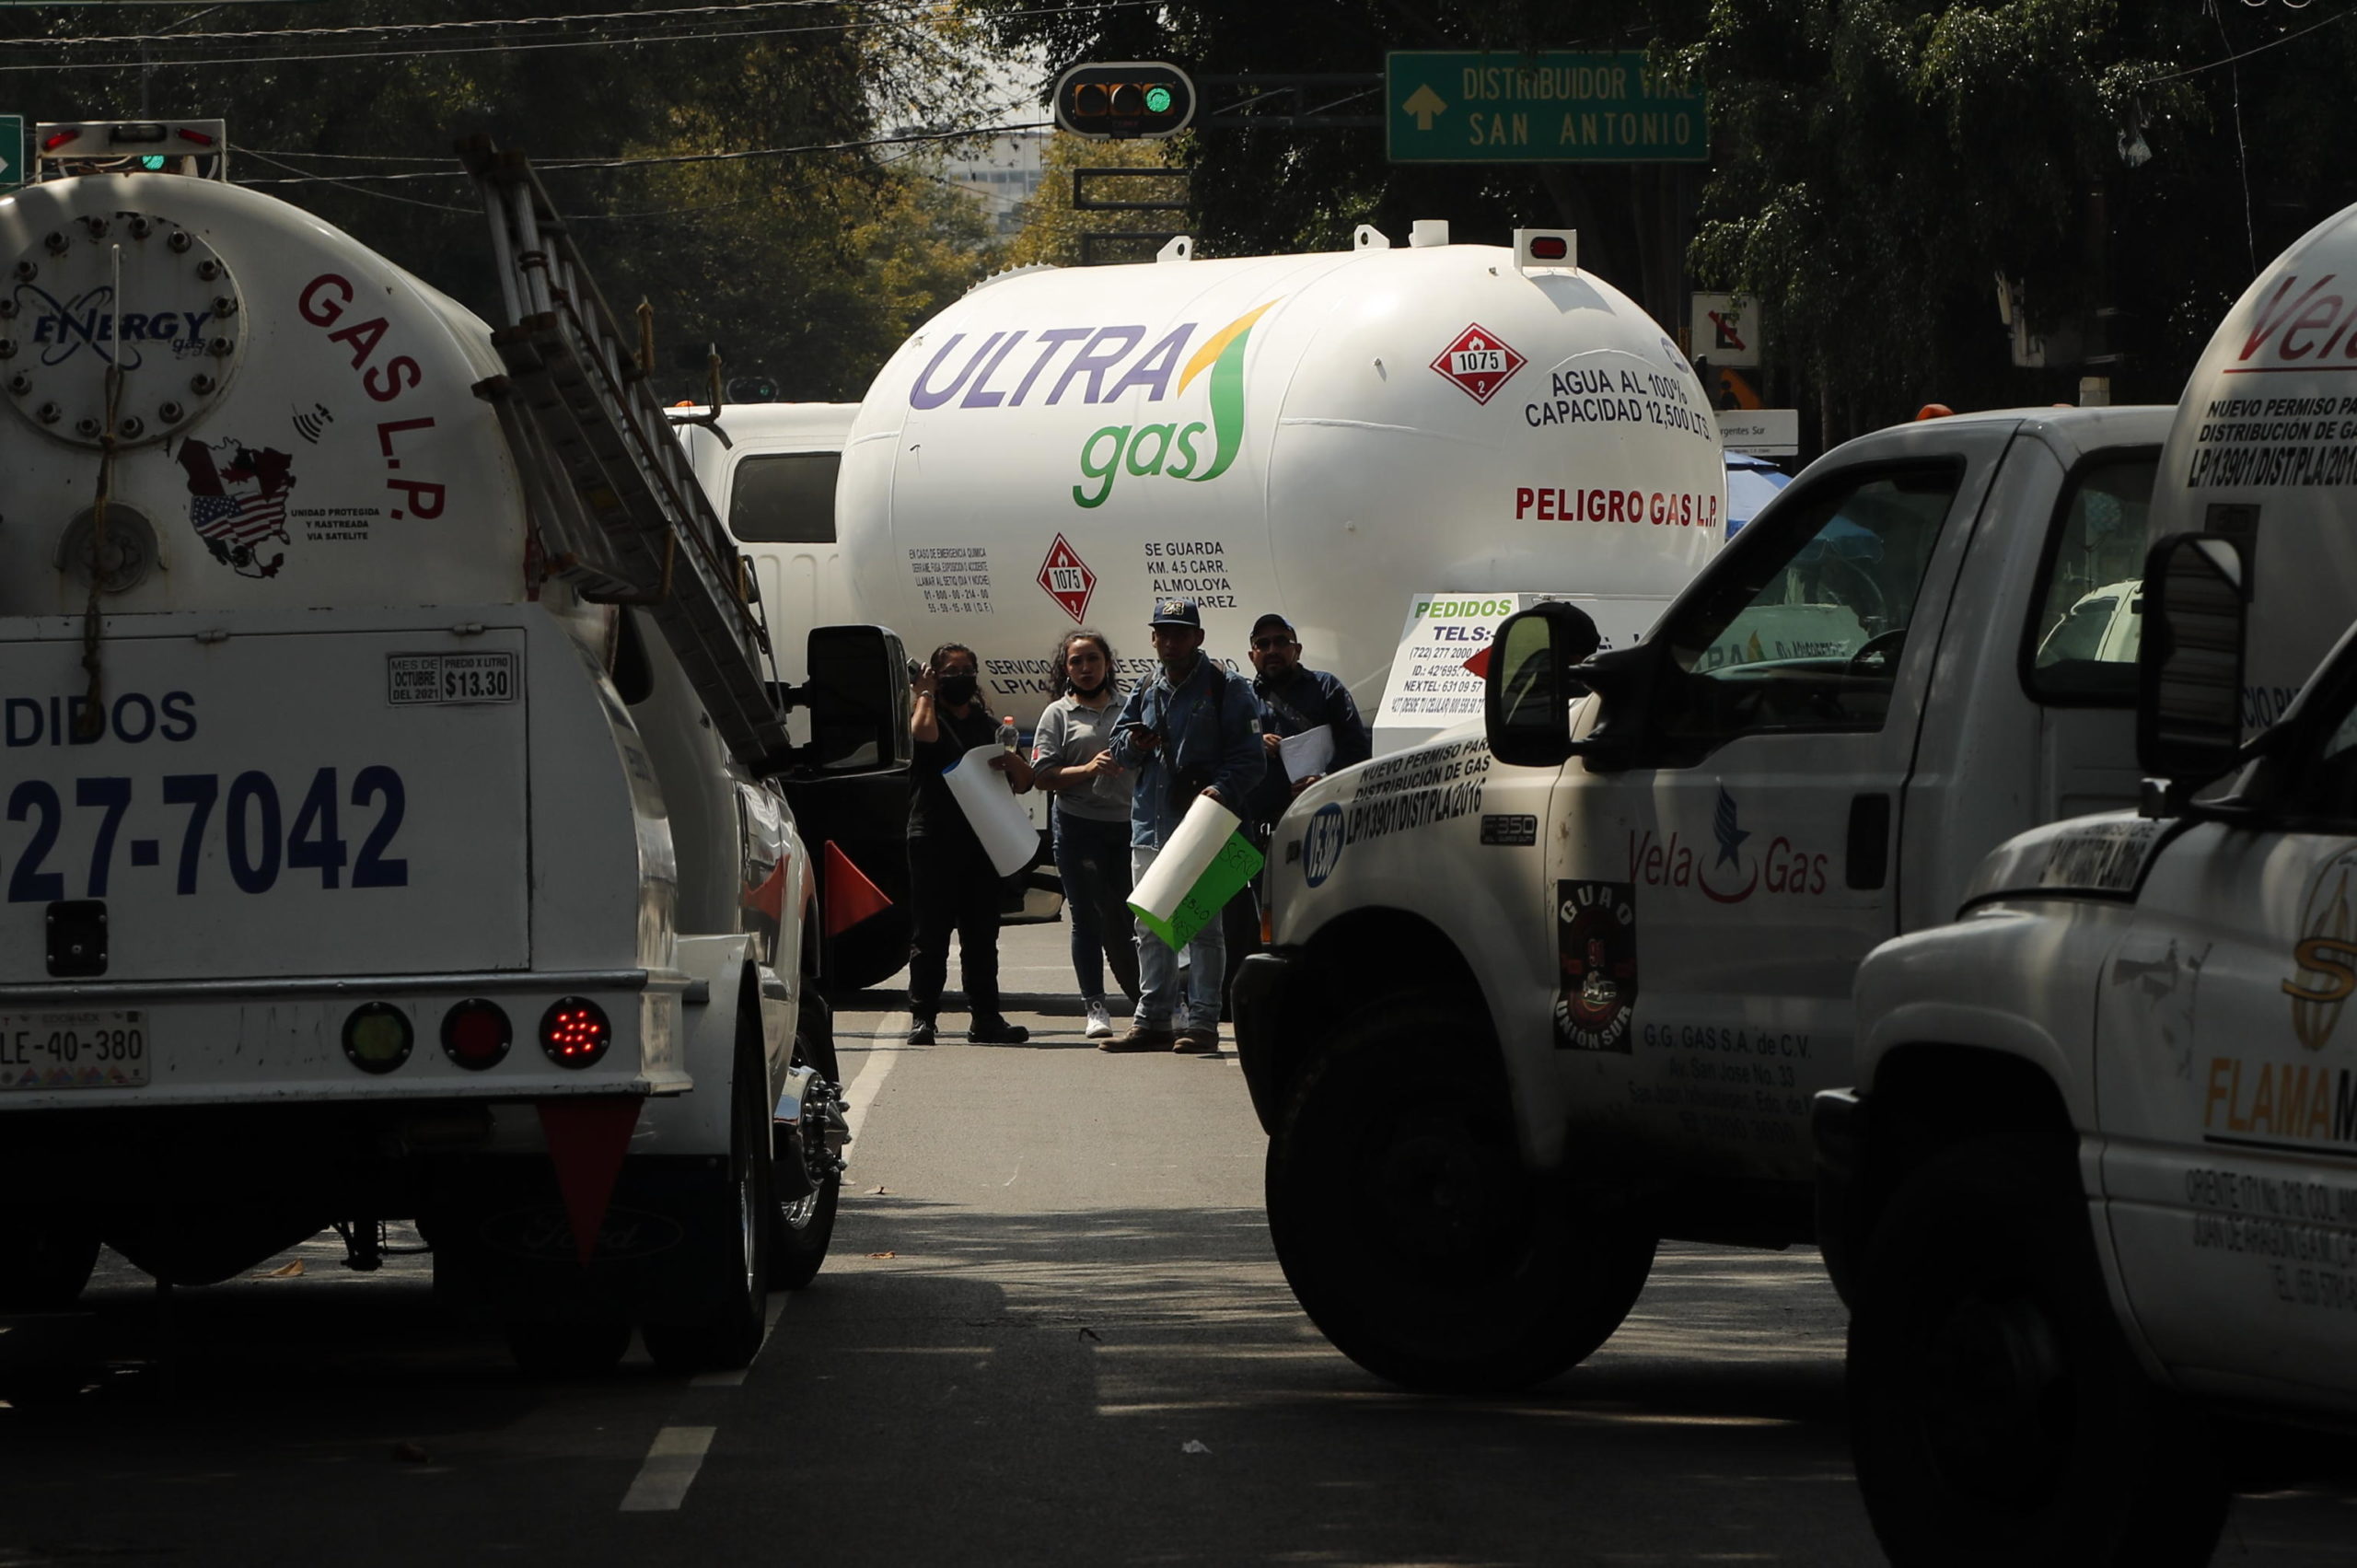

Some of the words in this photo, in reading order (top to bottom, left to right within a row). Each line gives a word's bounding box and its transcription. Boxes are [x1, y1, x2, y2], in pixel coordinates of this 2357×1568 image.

[1463, 66, 1626, 100] DISTRIBUIDOR
[1469, 111, 1528, 146] SAN
[1560, 110, 1691, 146] ANTONIO
[33, 308, 213, 344] ENERGY
[2238, 274, 2357, 361] Vel
[298, 273, 422, 402] GAS
[910, 323, 1199, 410] ULTRA
[1458, 351, 1500, 372] 1075
[1478, 380, 1486, 395] 2
[1552, 369, 1615, 397] AGUA
[1620, 370, 1647, 394] AL
[1648, 373, 1688, 405] 100%
[2208, 400, 2262, 418] NUEVO
[2263, 397, 2338, 417] PERMISO
[1525, 399, 1642, 427] CAPACIDAD
[1646, 401, 1689, 431] 12,500
[1689, 411, 1713, 442] LTS.
[1752, 426, 1765, 435] Sur
[2199, 417, 2313, 442] DISTRIBUCIÓN
[2313, 422, 2339, 440] DE
[1073, 422, 1208, 508] gas
[291, 509, 326, 517] UNIDAD
[328, 508, 380, 517] PROTEGIDA
[1516, 487, 1644, 523] PELIGRO
[1650, 493, 1691, 527] GAS
[306, 520, 312, 528] Y
[314, 519, 369, 528] RASTREADA
[307, 532, 323, 540] VIA
[326, 532, 369, 540] SATELITE
[1144, 543, 1163, 556] SE
[1166, 541, 1225, 556] GUARDA
[1053, 569, 1080, 589] 1075
[1147, 561, 1169, 574] KM.
[1171, 560, 1187, 574] 4.5
[1190, 560, 1228, 573] CARR.
[1153, 578, 1232, 592] ALMOLOYA
[1071, 599, 1078, 614] 2
[1415, 599, 1512, 619] PEDIDOS
[391, 660, 418, 670] MES
[422, 659, 438, 670] DE
[445, 658, 474, 669] PRECIO
[476, 657, 482, 668] X
[484, 656, 508, 668] LITRO
[1410, 646, 1432, 661] (722)
[1433, 647, 1451, 659] 277
[1451, 647, 1473, 659] 2000
[395, 671, 436, 687] OCTUBRE
[985, 659, 1051, 675] SERVICIO
[1129, 658, 1160, 673] EST
[393, 690, 412, 700] DEL
[415, 689, 439, 700] 2021
[445, 670, 508, 698] $13.30
[1403, 680, 1439, 692] NEXTEL:
[1441, 680, 1458, 692] 631
[1457, 681, 1469, 692] 09
[6, 691, 197, 747] DIDOS
[1359, 758, 1403, 784] NUEVO
[1404, 743, 1462, 772] PERMISO
[1353, 767, 1442, 804] DISTRIBUCIÓN
[1444, 761, 1462, 782] DE
[1464, 755, 1492, 776] GAS
[6, 764, 409, 903] 27-7042
[1628, 830, 1693, 888] Vela
[1764, 836, 1829, 896] Gas
[1601, 1005, 1631, 1046] SUR
[0, 1029, 143, 1064] LE-40-380
[1644, 1024, 1678, 1047] G.G.
[1682, 1026, 1716, 1051] GAS
[1721, 1028, 1753, 1054] S.A.
[1758, 1032, 1776, 1056] de
[1781, 1033, 1812, 1059] C.V.
[1690, 1057, 1716, 1082] San
[1720, 1061, 1750, 1084] Jose
[1753, 1063, 1776, 1086] No.
[1778, 1065, 1795, 1087] 33
